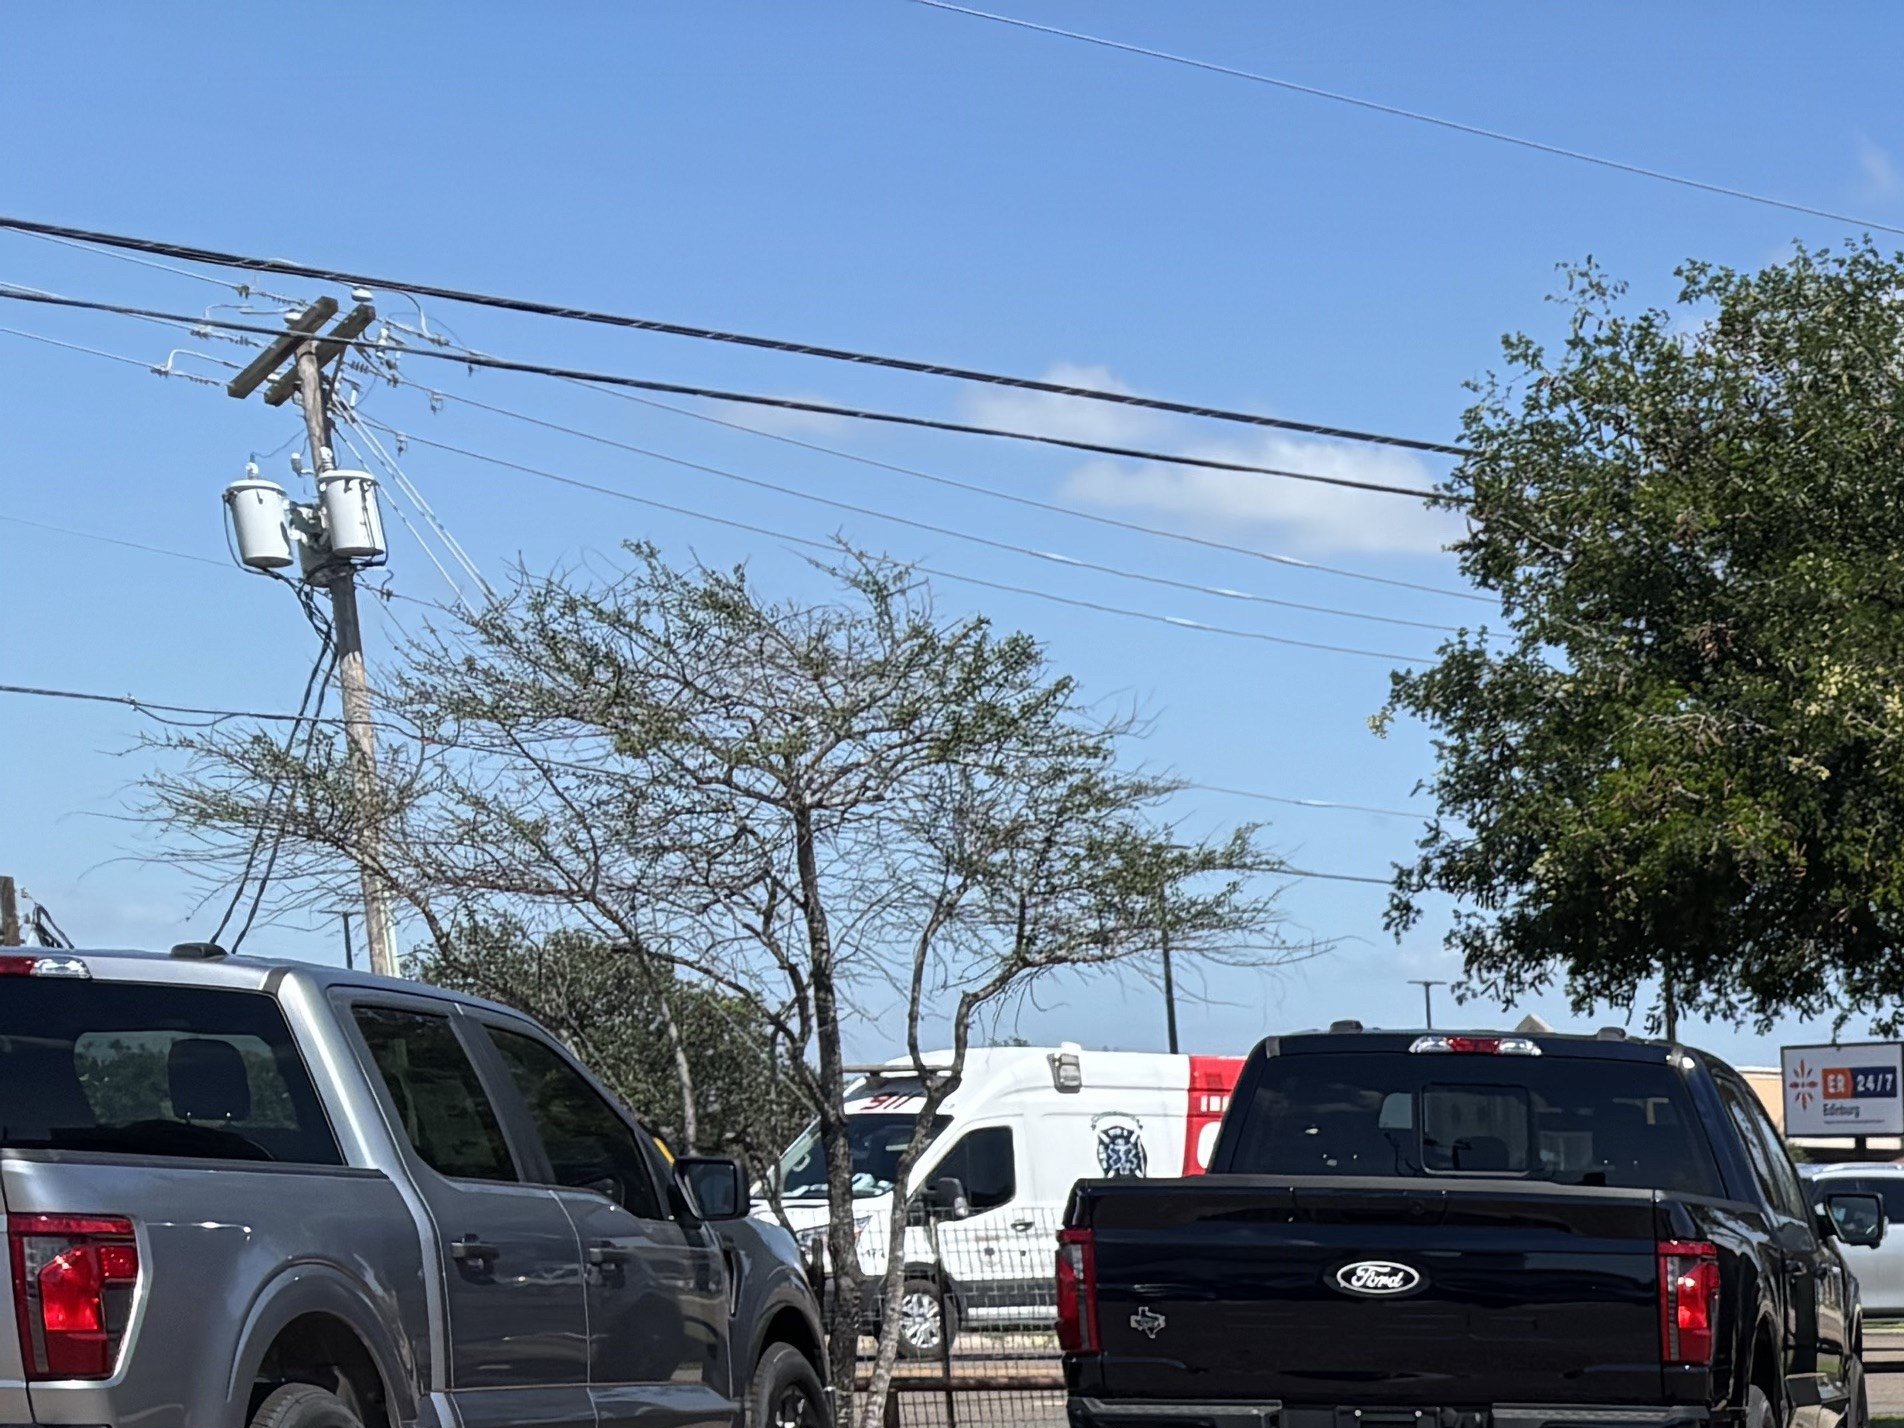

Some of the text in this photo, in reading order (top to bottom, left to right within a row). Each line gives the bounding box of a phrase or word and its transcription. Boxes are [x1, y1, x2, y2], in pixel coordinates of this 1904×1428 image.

[1827, 1073, 1893, 1094] ER 24/7
[1351, 1265, 1404, 1288] Ford
